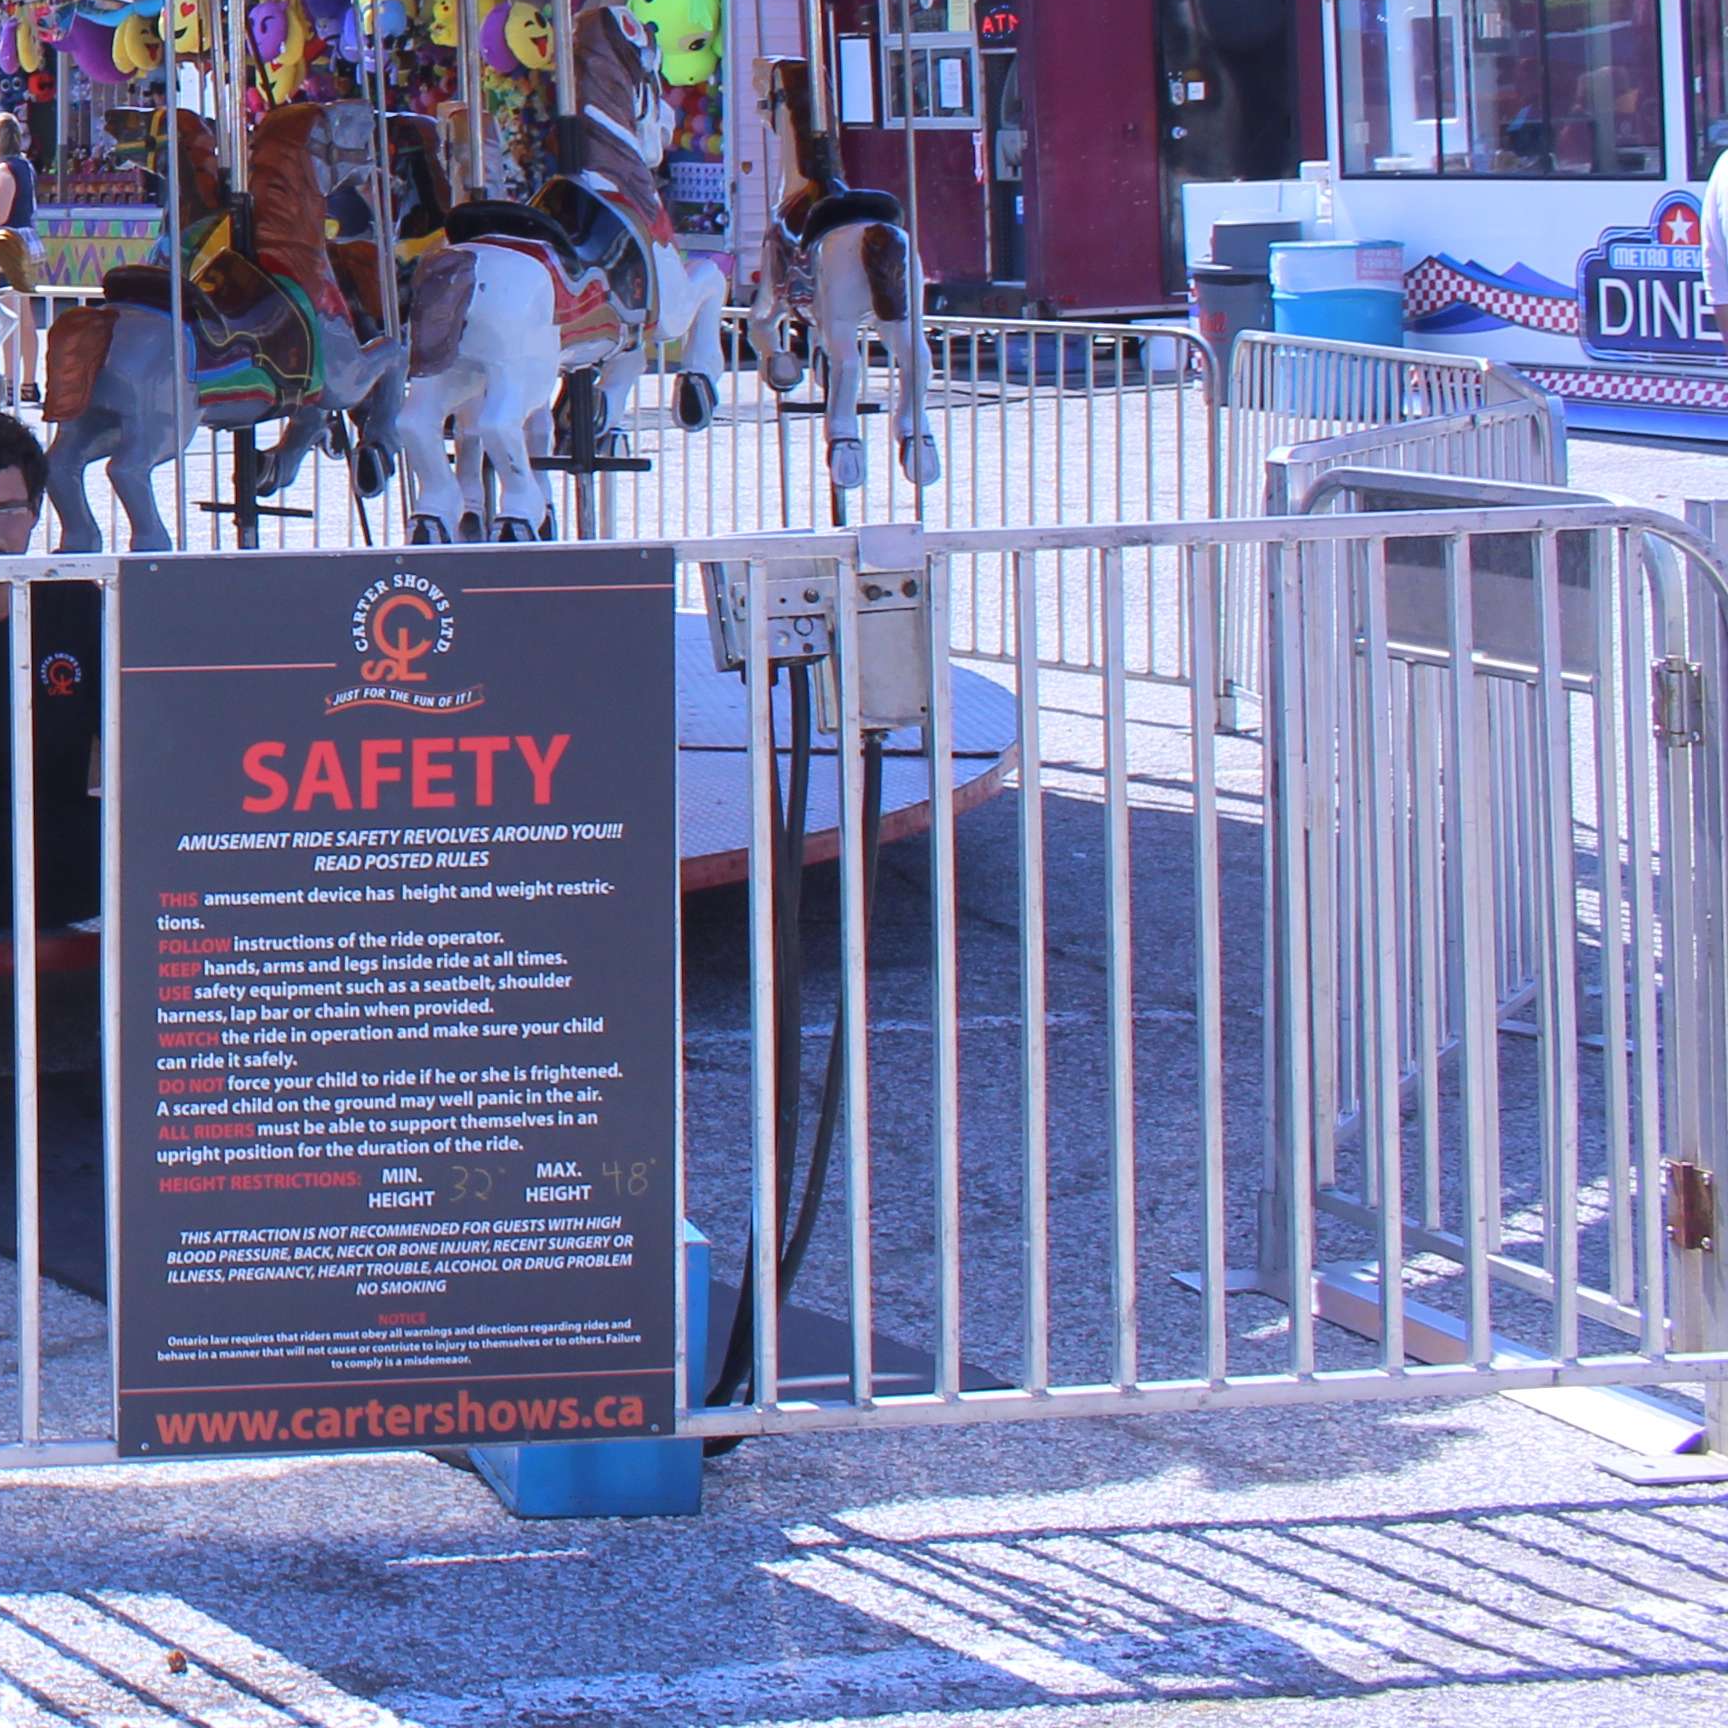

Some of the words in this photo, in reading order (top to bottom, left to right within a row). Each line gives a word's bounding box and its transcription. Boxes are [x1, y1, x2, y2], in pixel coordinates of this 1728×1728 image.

[1614, 247, 1668, 267] METRO
[352, 579, 389, 653] CARTER
[393, 572, 450, 613] SHOWS
[332, 688, 359, 706] JUST
[363, 686, 385, 698] FOR
[389, 689, 409, 703] THE
[412, 694, 434, 708] FUN
[438, 695, 453, 707] OF
[455, 691, 472, 704] IT!
[241, 733, 572, 815] SAFETY
[177, 832, 292, 851] AMUSEMENT
[292, 831, 334, 849] RIDE
[335, 829, 402, 848] SAFETY
[403, 826, 491, 846] REVOLVES
[491, 824, 569, 843] AROUND
[571, 823, 624, 840] YOU!!!
[314, 854, 363, 872] READ
[364, 852, 434, 871] POSTED
[435, 850, 491, 868] RULES
[159, 891, 199, 908] THIS
[204, 889, 305, 907] amusement
[307, 886, 363, 903] device
[365, 885, 396, 902] has
[402, 883, 458, 904] height
[460, 882, 493, 899] and
[495, 880, 554, 901] weight
[556, 878, 616, 896] restric-
[157, 914, 206, 932] tions.
[158, 937, 232, 955] FOLLOW
[233, 933, 335, 952] instructions
[338, 932, 356, 949] of
[358, 931, 388, 949] the
[390, 930, 425, 947] ride
[427, 931, 505, 950] operator.
[158, 961, 202, 979] KEEP
[204, 958, 261, 977] hands,
[262, 961, 305, 975] arms
[308, 956, 342, 973] and
[344, 955, 380, 975] legs
[382, 953, 434, 971] inside
[436, 952, 470, 969] ride
[472, 953, 491, 968] at
[493, 950, 514, 967] all
[517, 949, 569, 967] times.
[158, 985, 193, 1002] USE
[194, 982, 246, 1002] safety
[249, 980, 343, 1001] equipment
[345, 977, 385, 995] such
[388, 981, 408, 994] as
[410, 981, 421, 993] a
[423, 974, 496, 993] seatbelt,
[498, 972, 573, 990] shoulder
[158, 1031, 220, 1048] WATCH
[221, 1028, 250, 1046] the
[253, 1027, 288, 1044] ride
[290, 1026, 308, 1043] in
[310, 1024, 394, 1046] operation
[396, 1022, 430, 1040] and
[432, 1021, 479, 1039] make
[482, 1024, 519, 1037] sure
[521, 1022, 561, 1039] your
[563, 1016, 604, 1034] child
[158, 1078, 185, 1096] DO
[189, 1077, 225, 1094] NOT
[227, 1074, 271, 1092] force
[273, 1076, 314, 1094] your
[316, 1071, 358, 1089] child
[360, 1073, 380, 1088] to
[382, 1069, 417, 1087] ride
[419, 1068, 432, 1085] if
[434, 1068, 457, 1085] he
[459, 1071, 478, 1084] or
[481, 1066, 511, 1083] she
[513, 1065, 528, 1082] is
[530, 1062, 624, 1084] frightened.
[158, 1124, 191, 1141] ALL
[193, 1122, 256, 1140] RIDERS
[257, 1121, 301, 1137] must
[303, 1119, 326, 1136] be
[328, 1117, 366, 1135] able
[368, 1119, 387, 1133] to
[389, 1116, 458, 1136] support
[460, 1111, 555, 1130] themselves
[558, 1109, 574, 1127] in
[577, 1113, 599, 1126] an
[382, 1168, 424, 1185] MIN.
[537, 1162, 583, 1179] MAX.
[159, 1175, 223, 1195] HEIGHT
[526, 1185, 593, 1204] HEIGHT
[369, 1191, 436, 1209] HEIGHT
[180, 1231, 212, 1245] THIS
[212, 1228, 301, 1245] ATTRACTION
[302, 1227, 316, 1241] IS
[317, 1226, 349, 1241] NOT
[349, 1222, 460, 1240] RECOMMENDED
[461, 1221, 491, 1235] FOR
[492, 1218, 546, 1234] GUESTS
[548, 1217, 584, 1232] WITH
[585, 1215, 622, 1231] HIGH
[166, 1250, 217, 1265] BLOOD
[218, 1247, 292, 1263] PRESSURE,
[293, 1246, 335, 1261] BACK,
[336, 1244, 374, 1259] NECK
[376, 1243, 397, 1257] OR
[398, 1242, 439, 1257] BONE
[439, 1239, 491, 1255] INJURY,
[492, 1238, 547, 1253] RECENT
[547, 1235, 612, 1251] SURGERY
[613, 1234, 634, 1248] OR
[356, 1282, 379, 1296] NO
[379, 1279, 447, 1295] SMOKING
[378, 1312, 426, 1325] NOTICE
[156, 1390, 645, 1444] www.cartershows.ca
